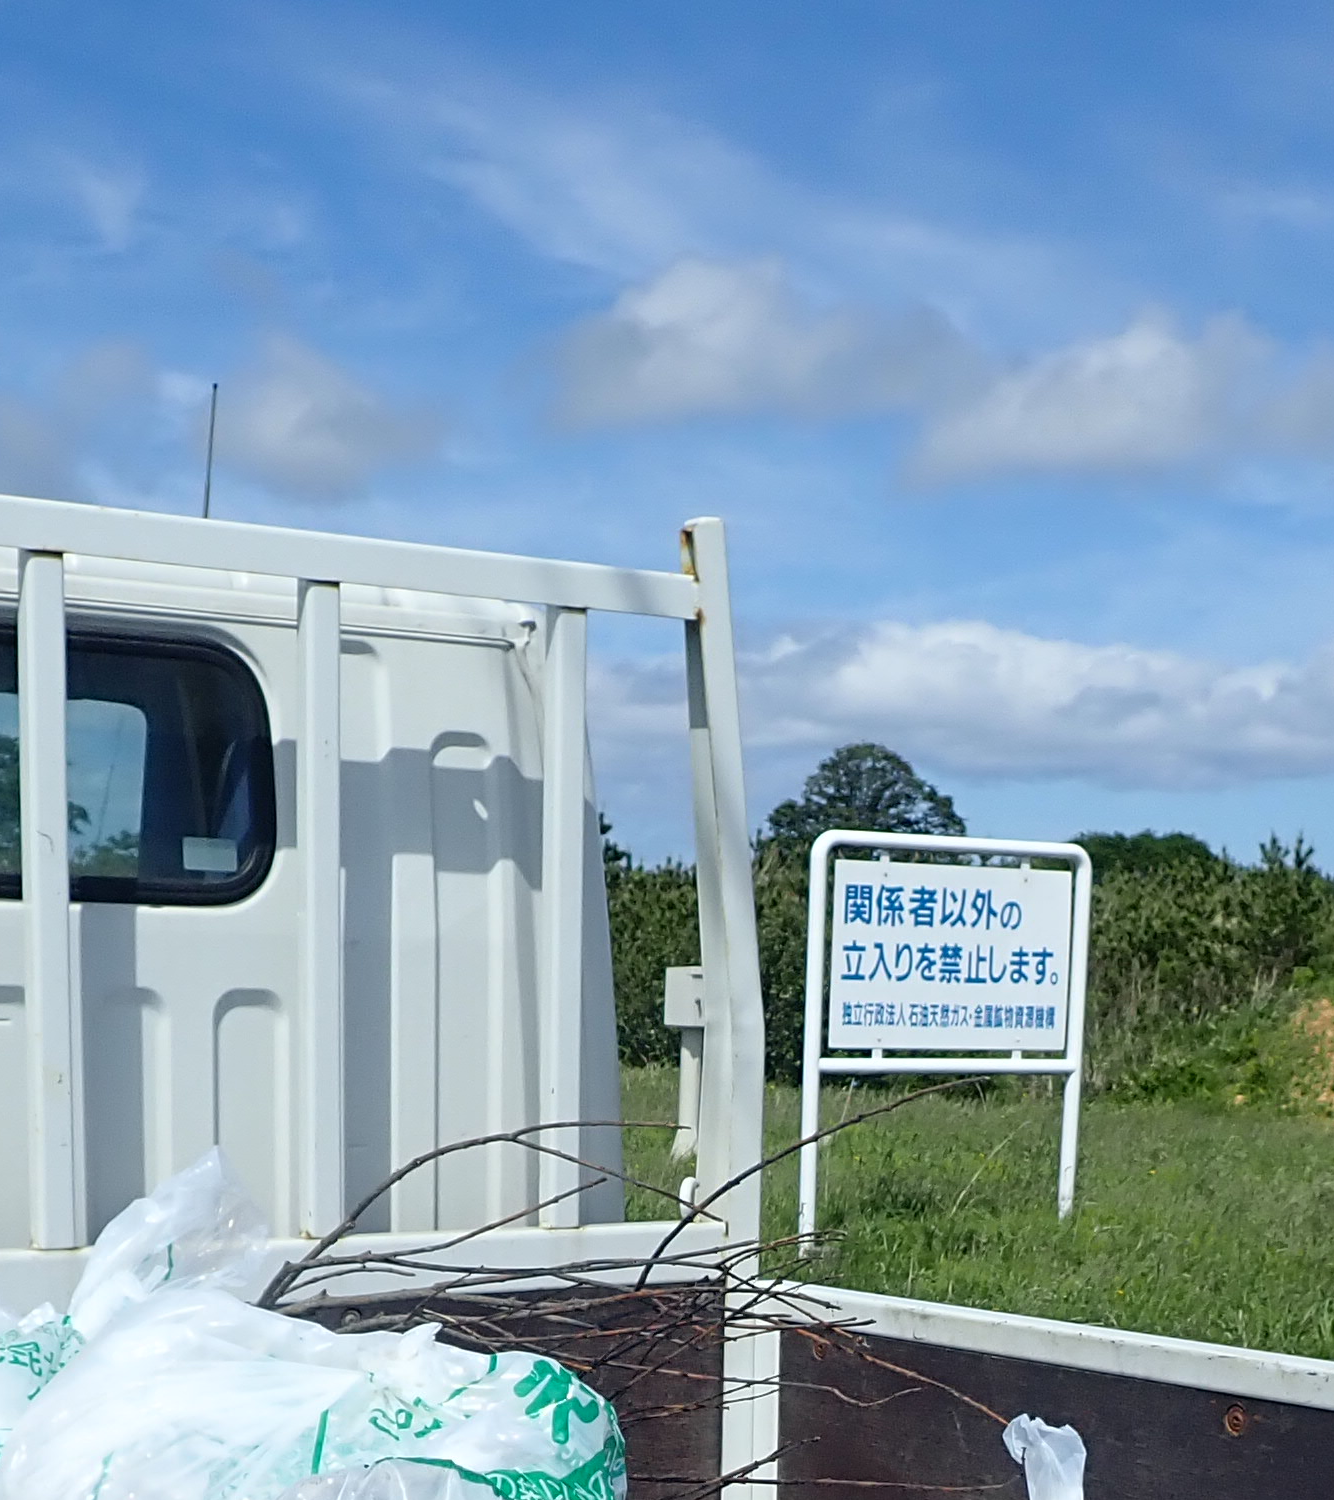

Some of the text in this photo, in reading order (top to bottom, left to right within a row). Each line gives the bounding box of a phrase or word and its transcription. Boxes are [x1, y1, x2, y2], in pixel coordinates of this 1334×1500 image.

[843, 883, 1022, 930] 関係者以外の
[840, 939, 1058, 985] 立入りを禁止します。
